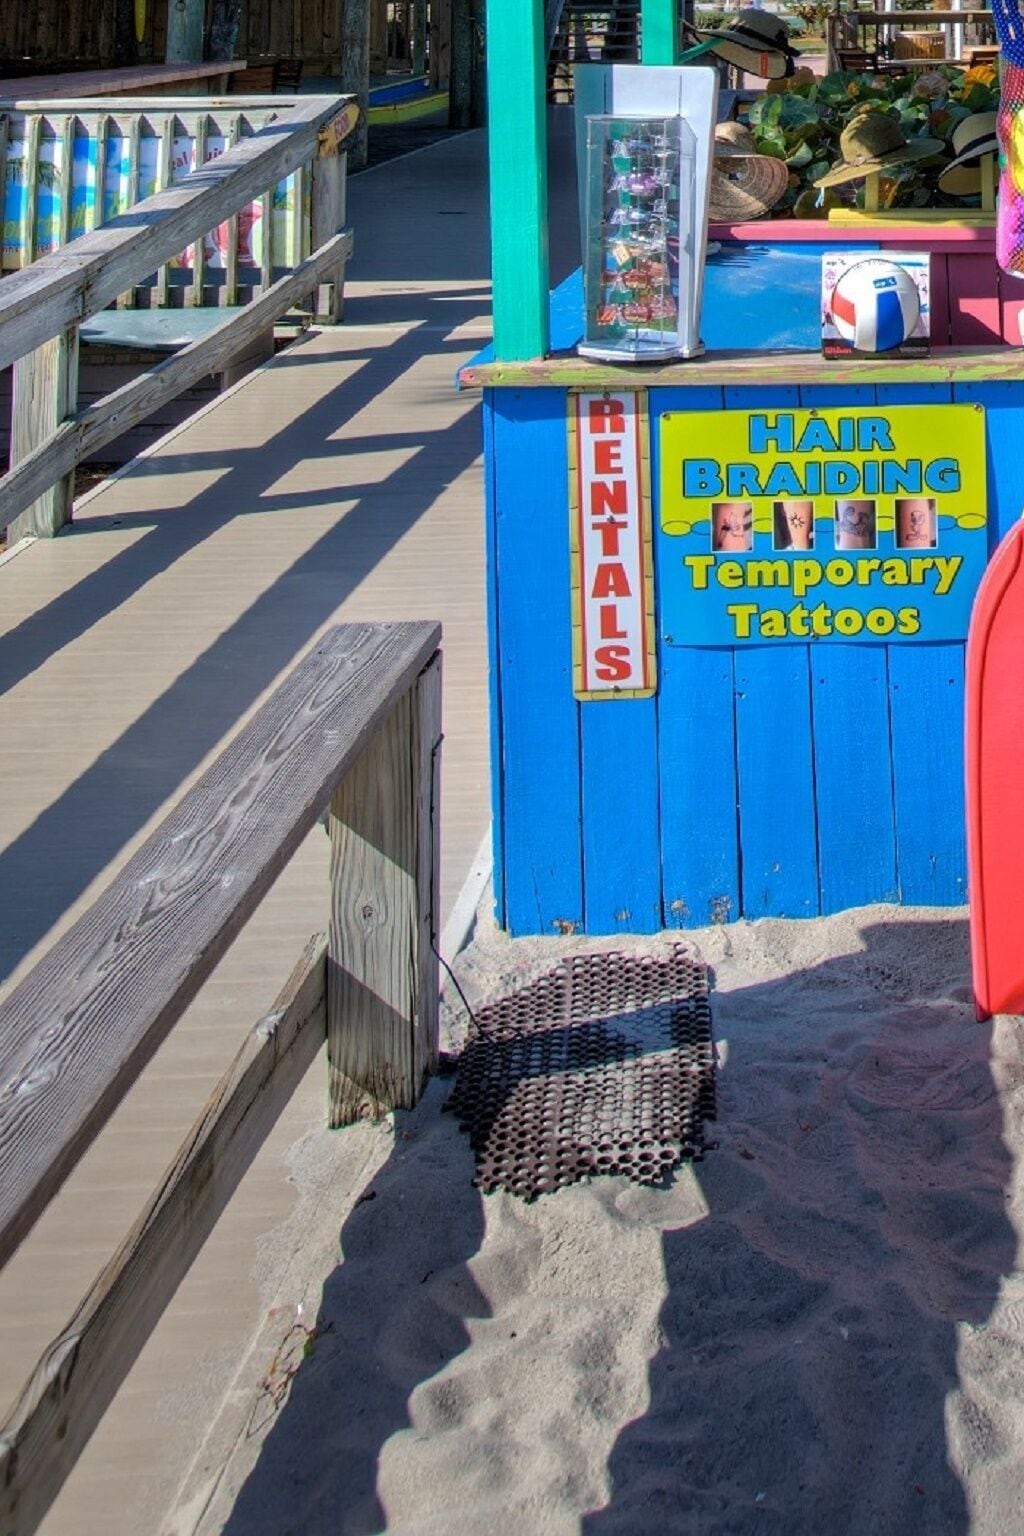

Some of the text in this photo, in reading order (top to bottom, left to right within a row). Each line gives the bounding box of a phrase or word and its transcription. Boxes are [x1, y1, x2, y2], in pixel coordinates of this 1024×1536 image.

[748, 413, 895, 453] HAIR
[682, 457, 961, 498] BRAIDING
[587, 398, 633, 682] RENTALS
[684, 554, 963, 597] Temporary
[727, 602, 921, 639] Tattoos
